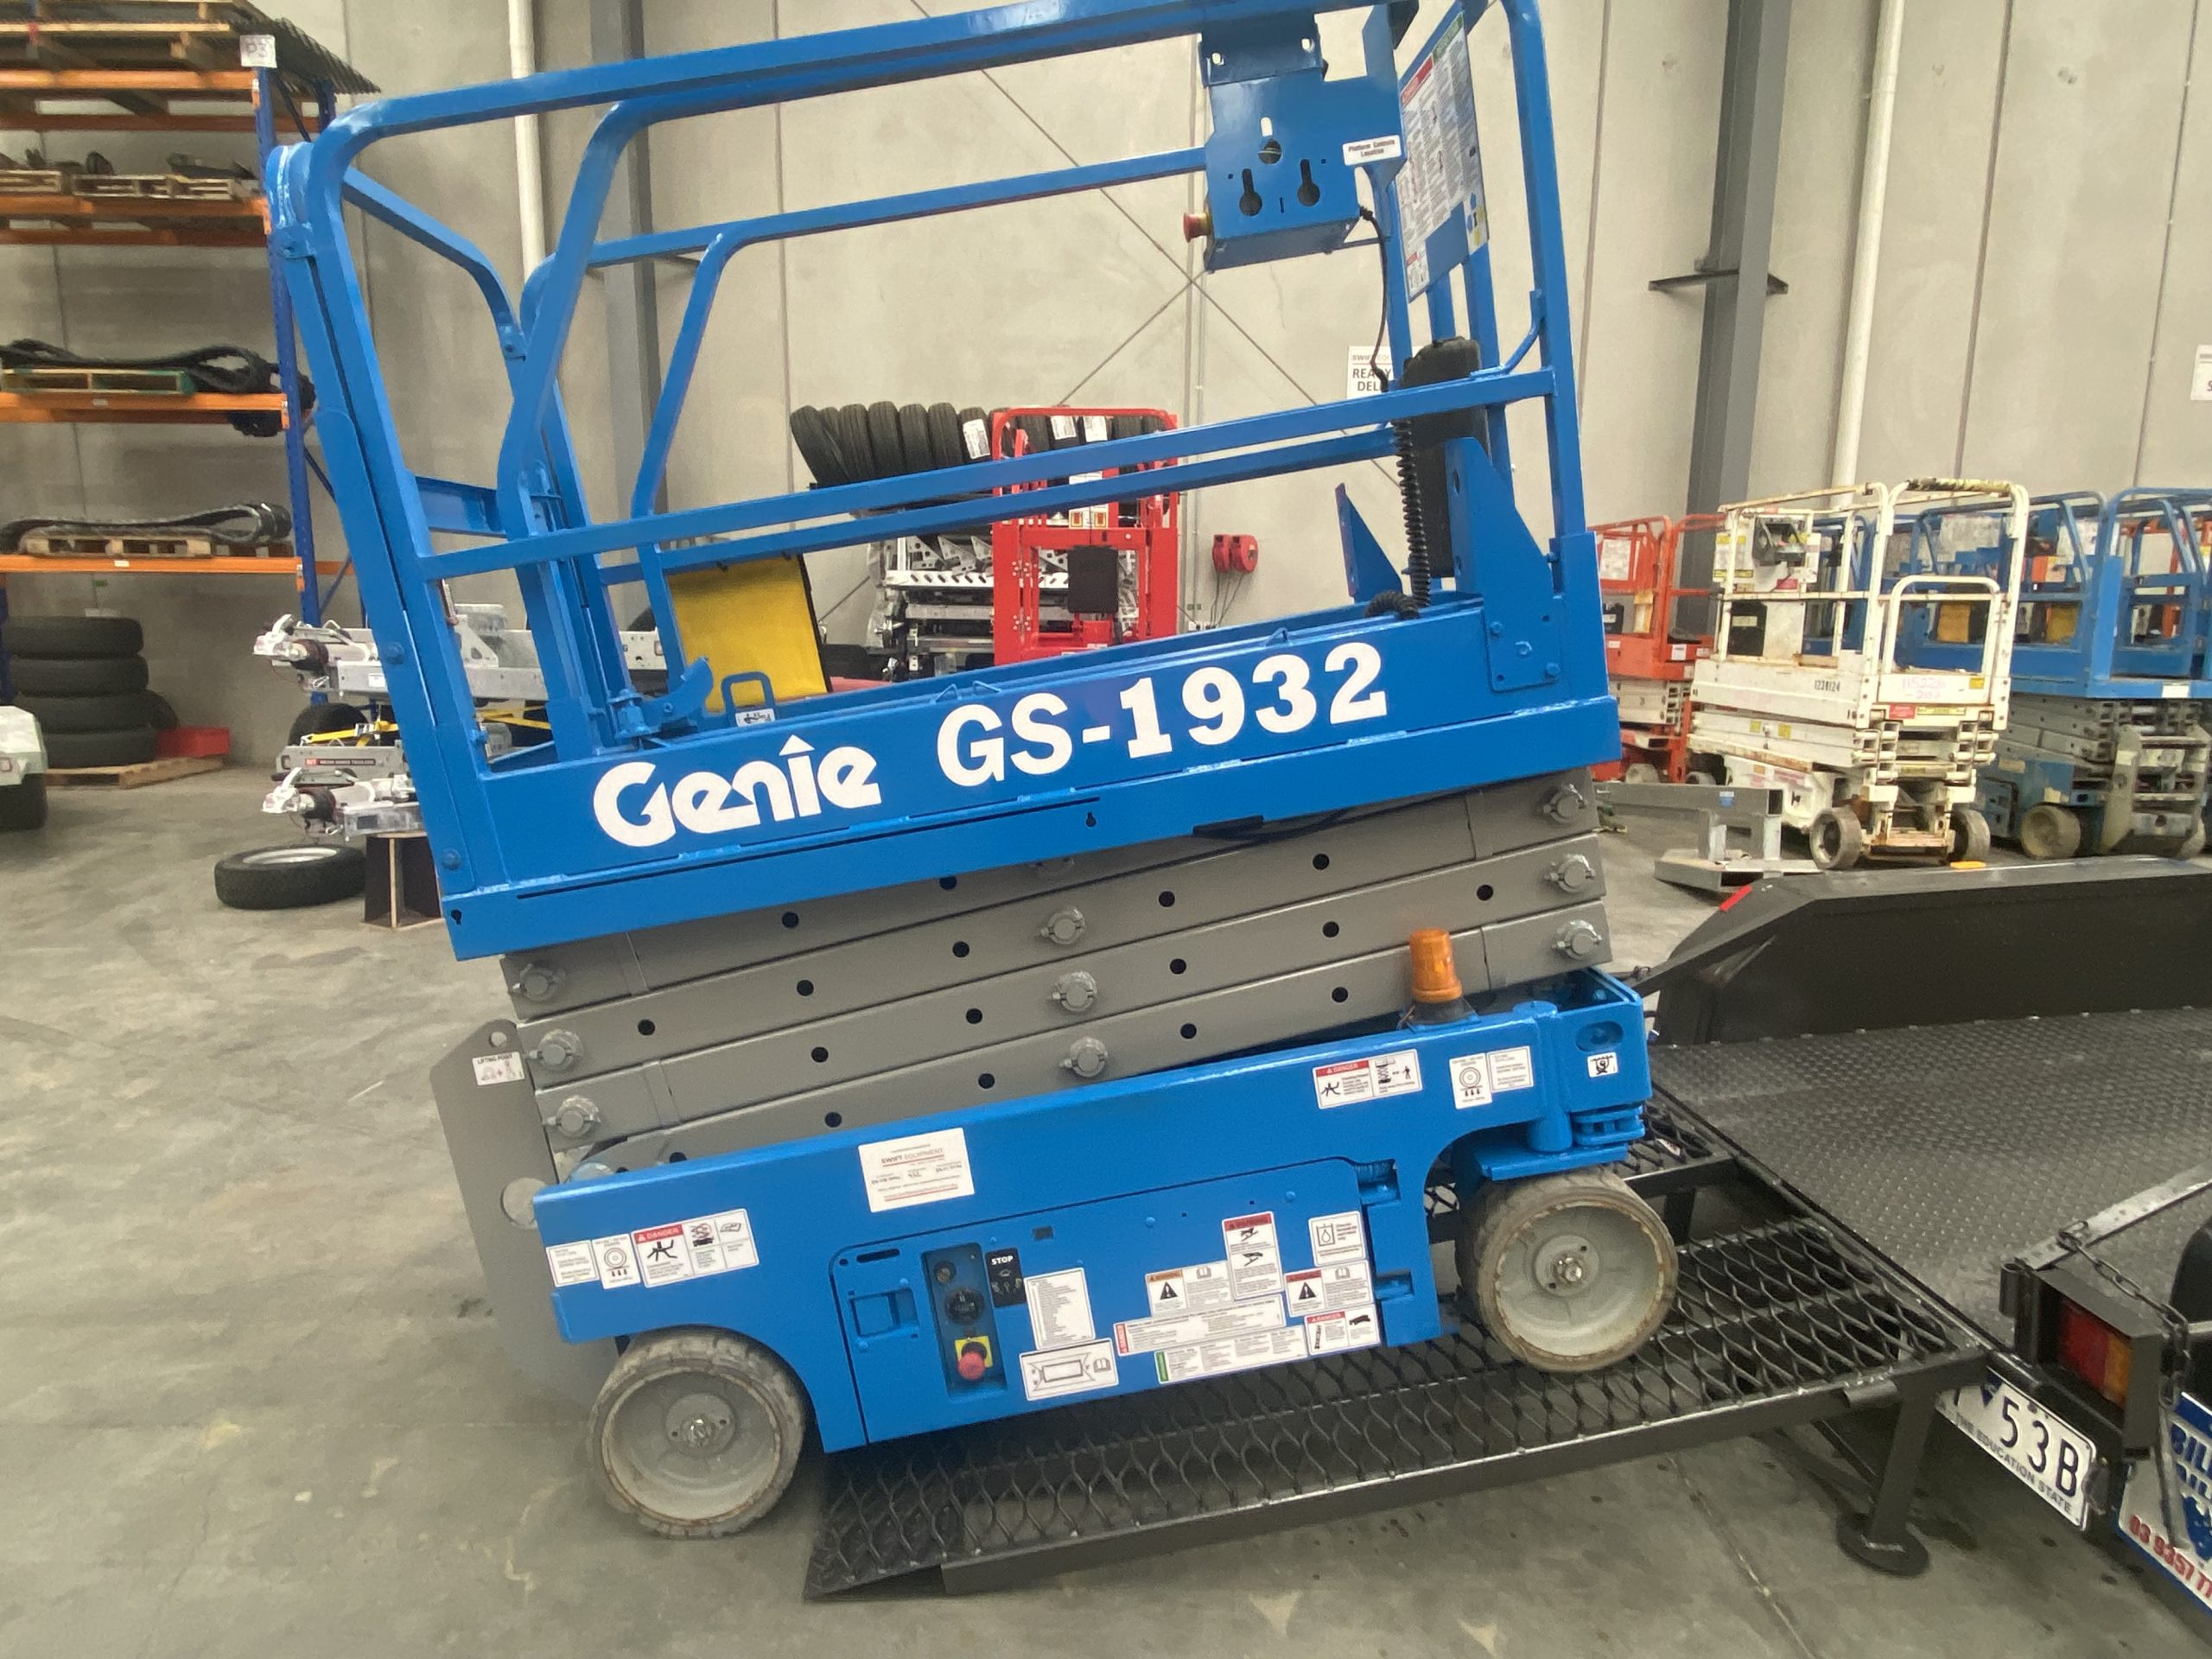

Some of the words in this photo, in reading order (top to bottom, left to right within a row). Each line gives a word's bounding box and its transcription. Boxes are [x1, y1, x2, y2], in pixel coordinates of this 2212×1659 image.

[1352, 368, 1391, 379] REAY
[1357, 381, 1379, 391] DEL
[937, 641, 1387, 787] GS-1932
[594, 734, 882, 847] Genie
[881, 1154, 903, 1164] SWIFT
[646, 1227, 679, 1239] DANGER
[991, 1255, 1014, 1265] STOP
[1999, 1395, 2079, 1497] 53B
[1976, 1429, 2036, 1484] EDUCATION
[2037, 1479, 2072, 1514] STATE
